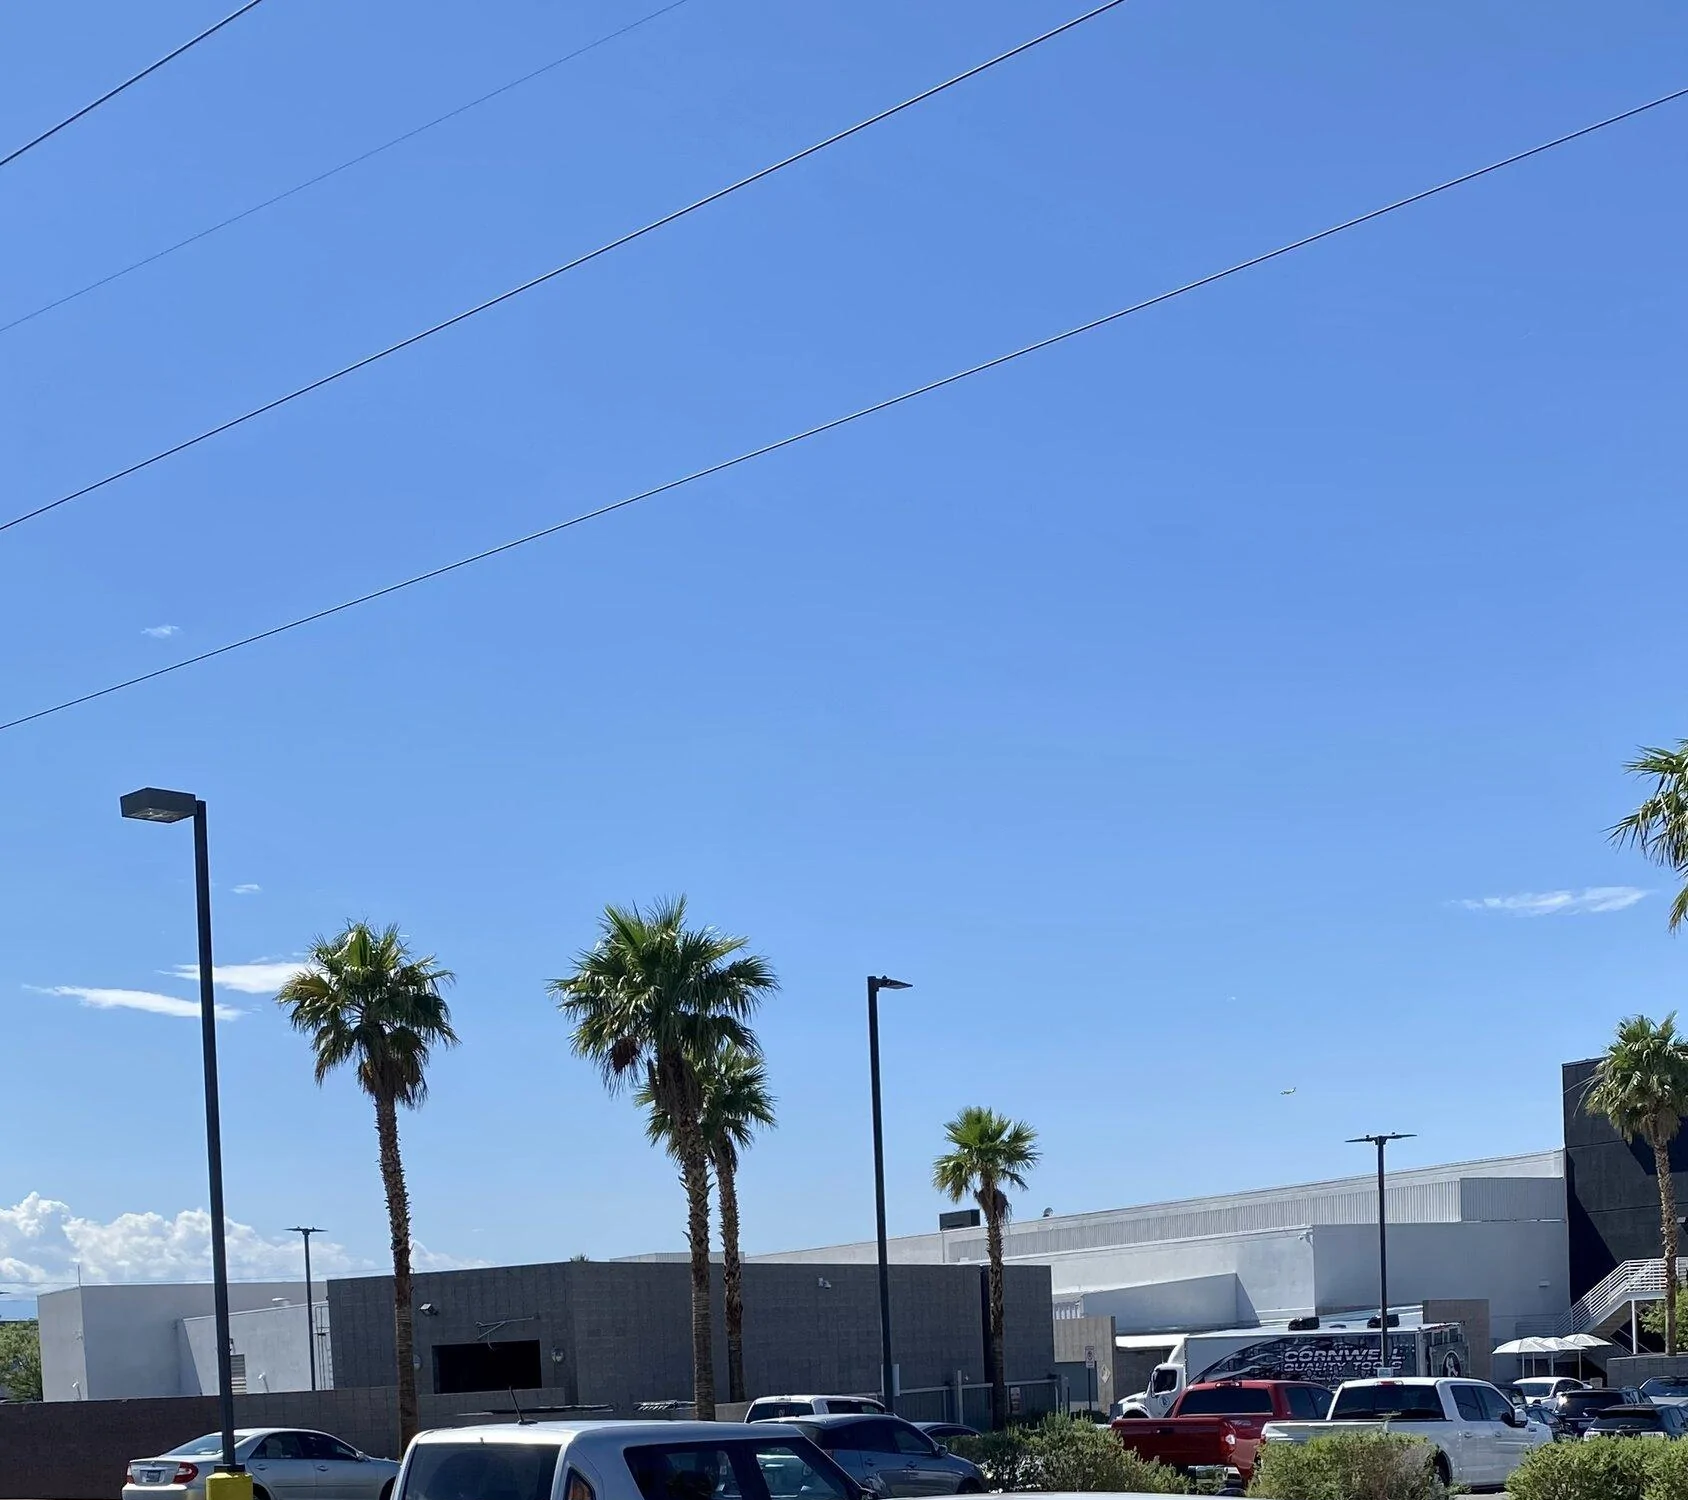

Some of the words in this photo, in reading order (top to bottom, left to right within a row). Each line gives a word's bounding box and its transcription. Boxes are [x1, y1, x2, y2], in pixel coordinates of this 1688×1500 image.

[1284, 1348, 1404, 1361] CORNWEL
[1284, 1362, 1346, 1371] QUALITY
[1353, 1361, 1402, 1370] TOOS
